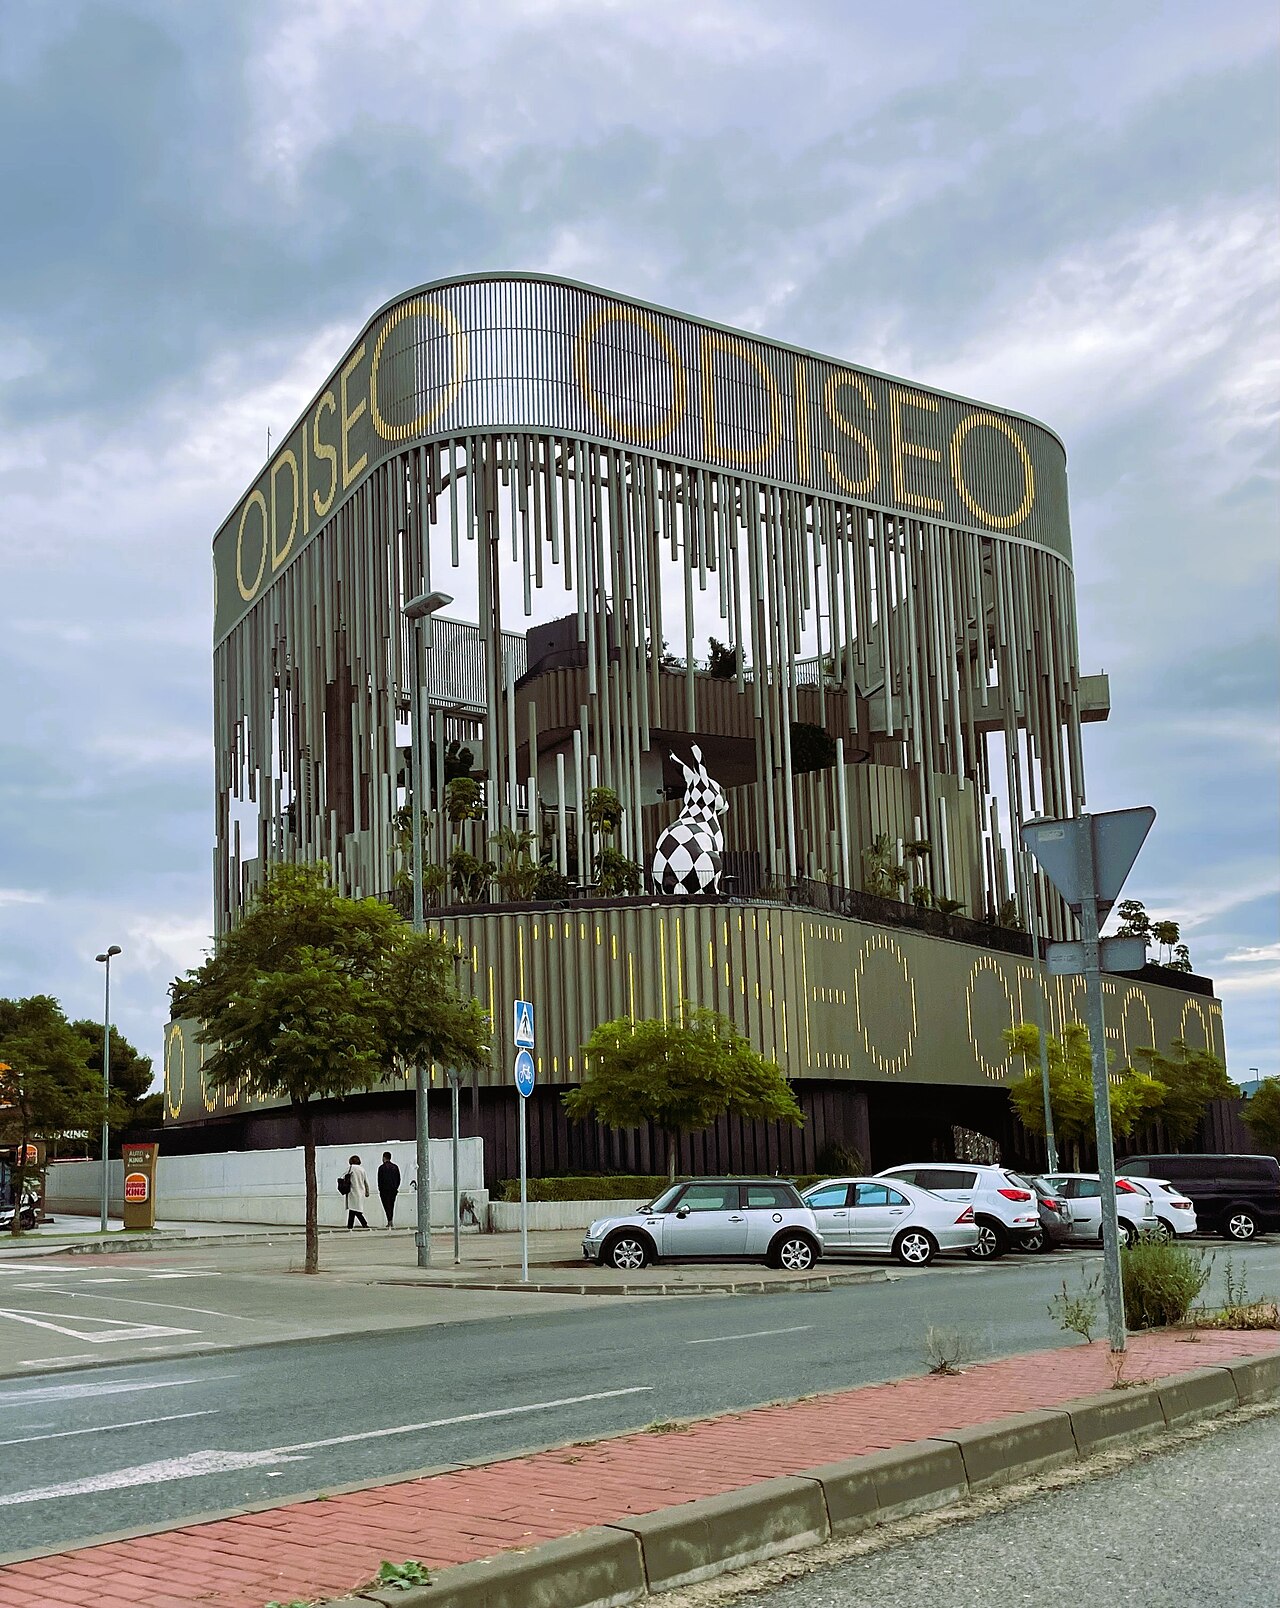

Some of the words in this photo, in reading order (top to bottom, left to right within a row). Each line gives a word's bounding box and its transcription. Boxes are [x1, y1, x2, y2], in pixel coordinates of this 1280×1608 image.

[236, 298, 468, 601] ODISEO
[572, 305, 1036, 529] ODISEO
[63, 1130, 89, 1139] KING
[126, 1188, 146, 1197] KING
